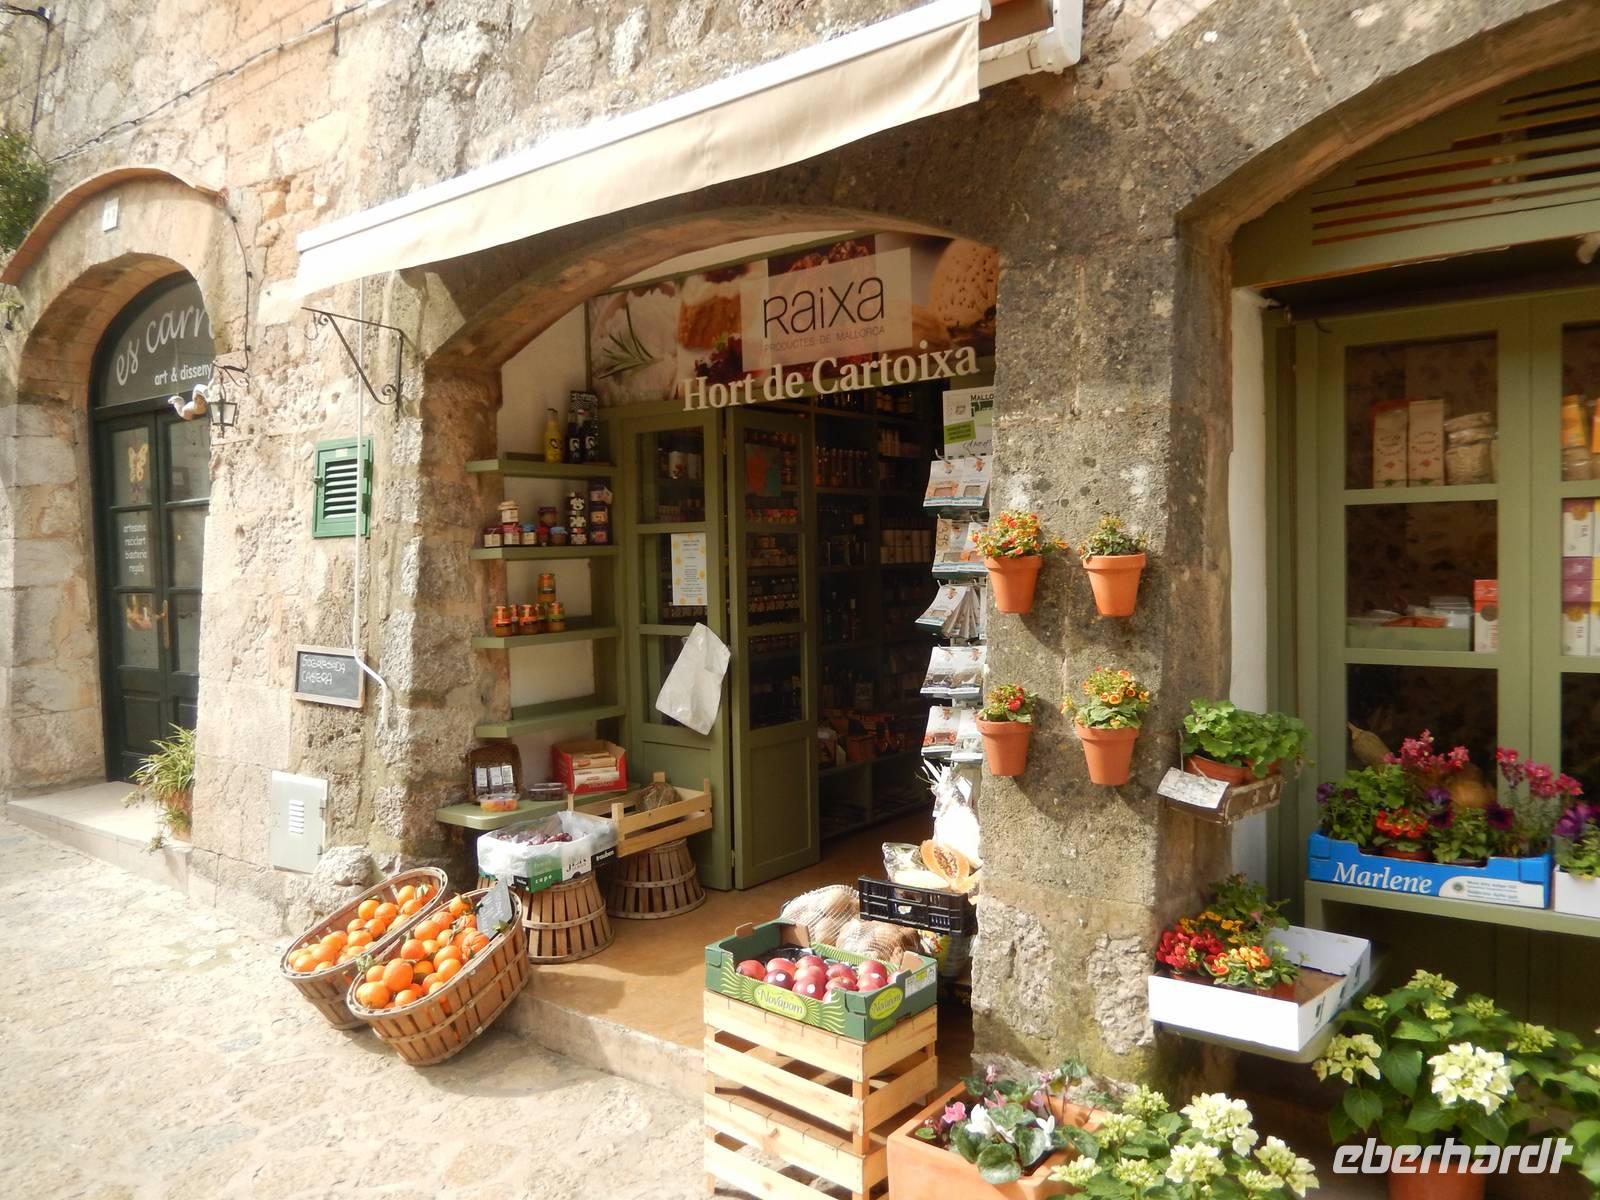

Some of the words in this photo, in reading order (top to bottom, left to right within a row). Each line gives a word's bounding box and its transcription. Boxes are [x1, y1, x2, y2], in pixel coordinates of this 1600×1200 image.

[116, 338, 140, 386] es
[146, 305, 215, 354] carr
[765, 337, 815, 352] PRODUCTES
[820, 335, 832, 344] DE
[836, 326, 885, 341] MALLORCA
[154, 370, 168, 385] art
[171, 367, 178, 382] &
[180, 363, 212, 380] disseny
[682, 375, 757, 411] Hort
[763, 364, 805, 402] de
[812, 340, 980, 395] Cartoixa
[1332, 862, 1433, 894] Marlene
